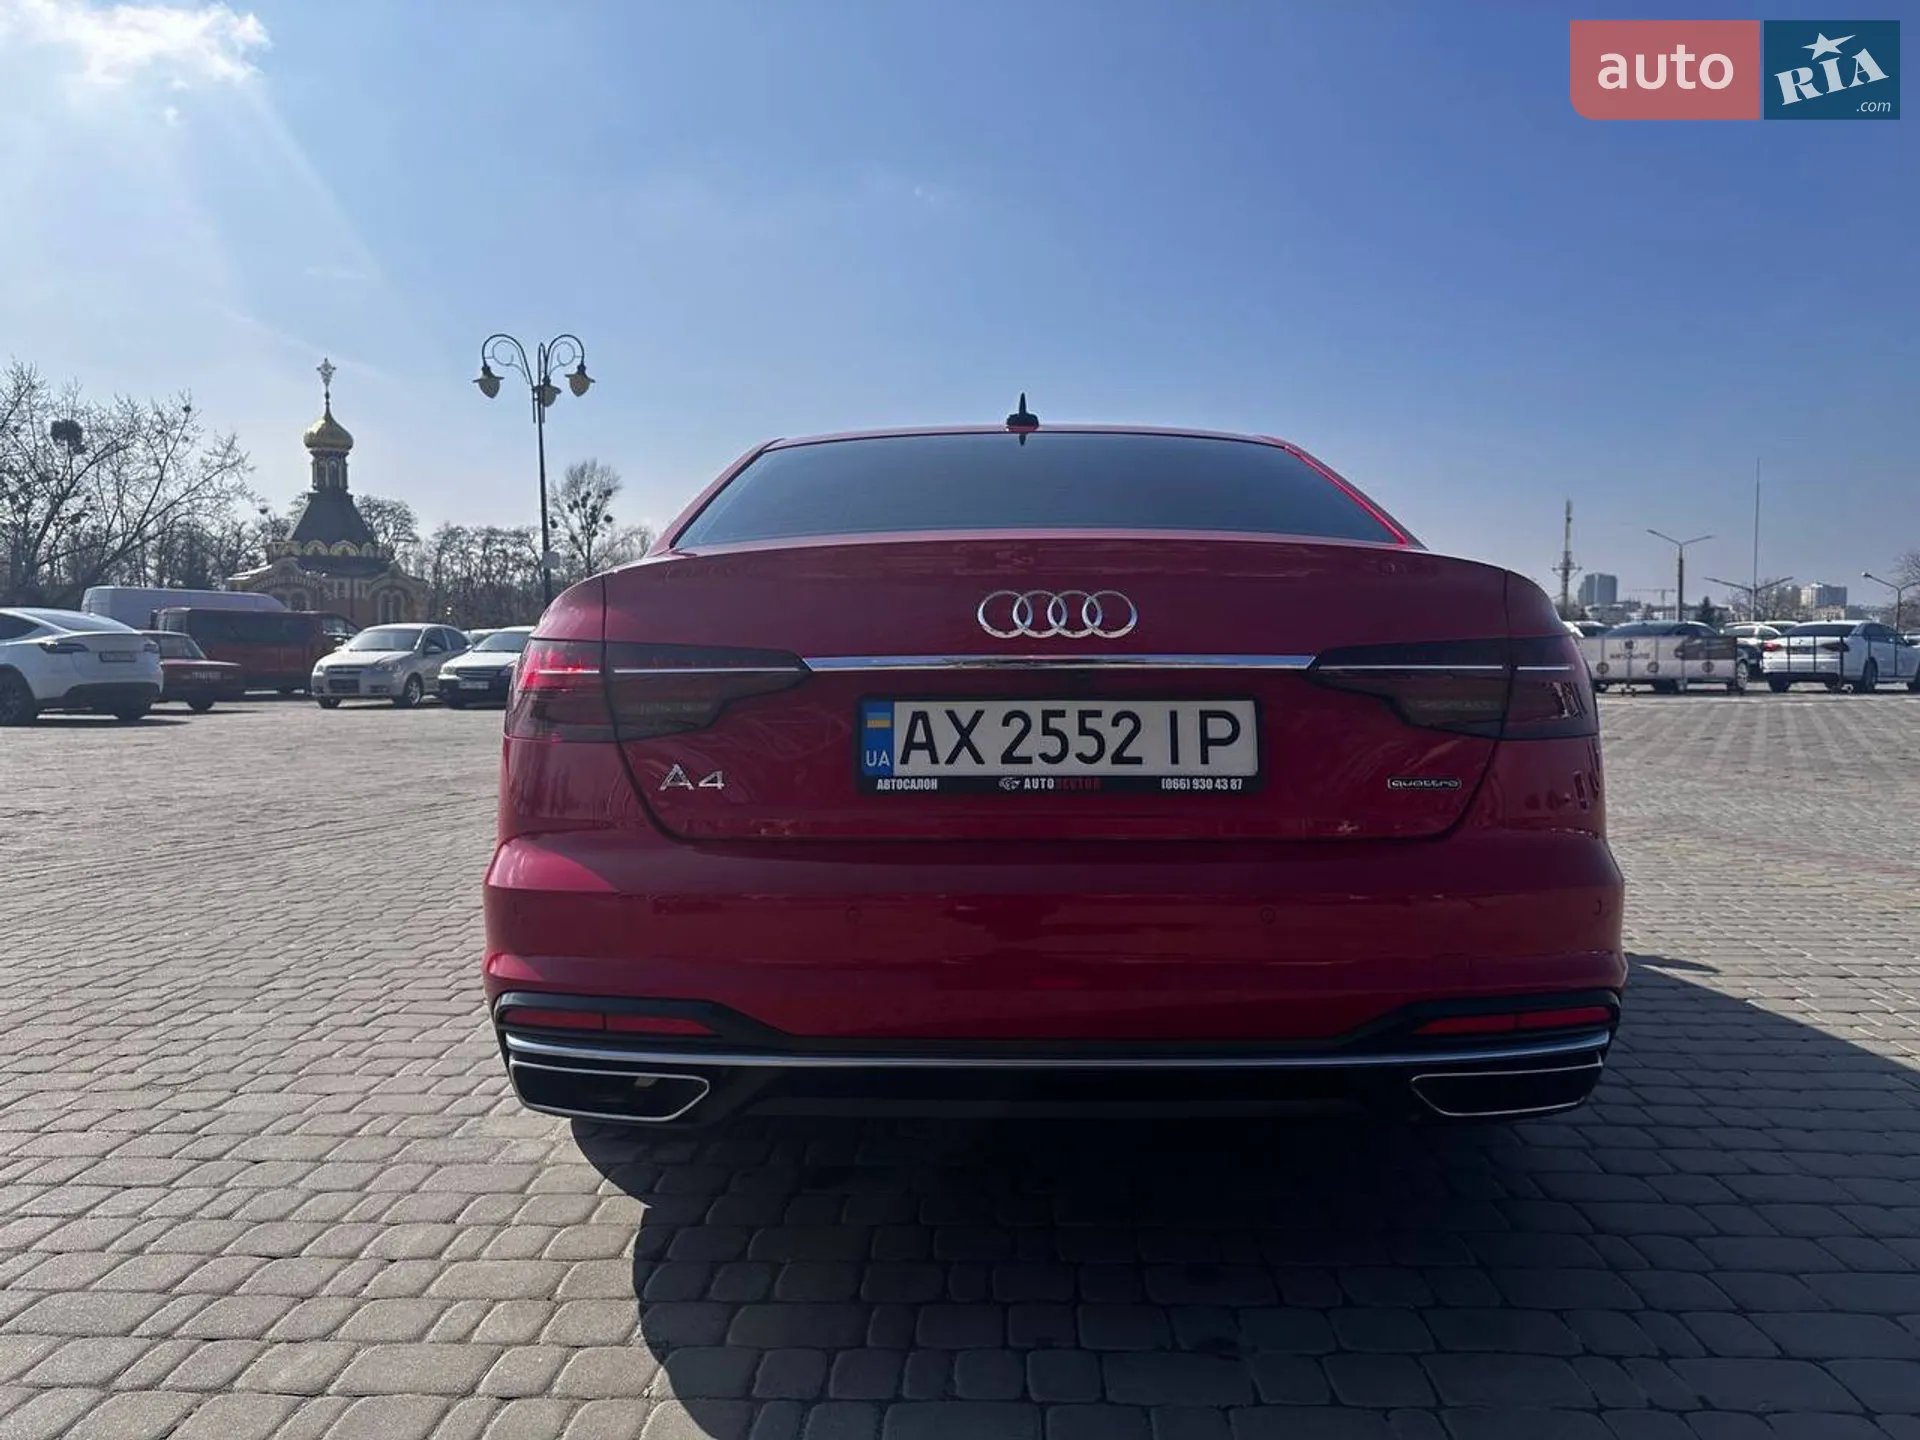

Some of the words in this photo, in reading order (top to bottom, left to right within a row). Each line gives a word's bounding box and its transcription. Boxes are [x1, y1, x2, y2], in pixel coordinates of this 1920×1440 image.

[900, 709, 986, 766] AX
[1001, 709, 1143, 765] 2552
[1170, 709, 1241, 765] IP
[866, 750, 891, 767] UA
[660, 763, 725, 791] A4
[877, 778, 938, 790] АВТОСАЛОН
[1391, 779, 1459, 788] quattro
